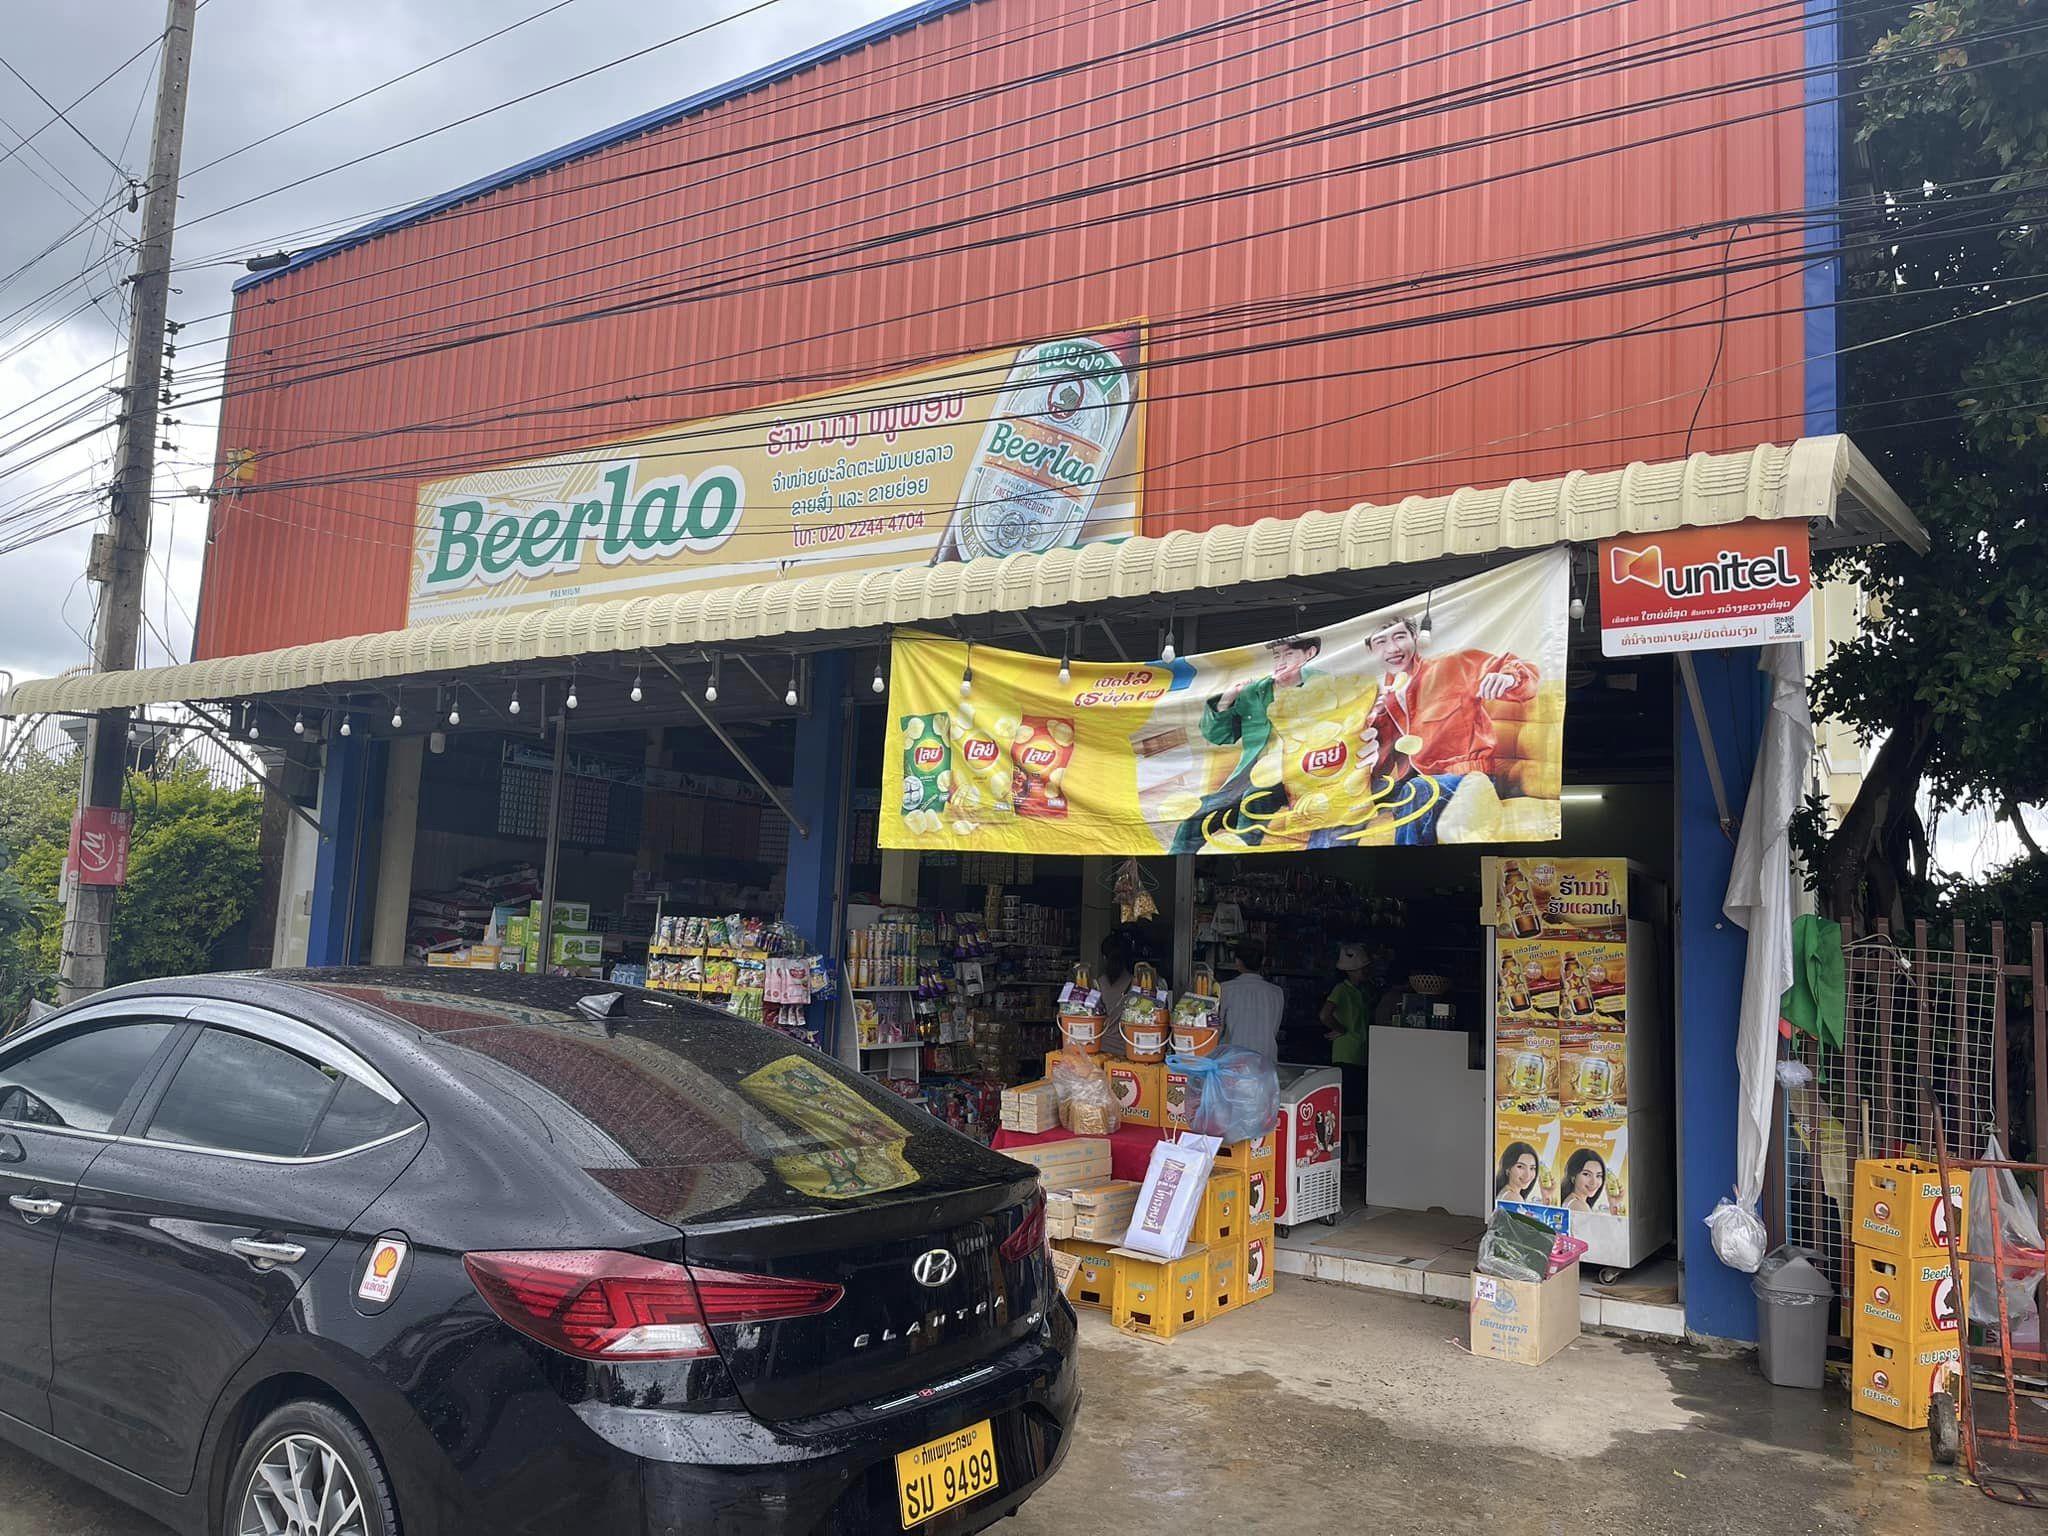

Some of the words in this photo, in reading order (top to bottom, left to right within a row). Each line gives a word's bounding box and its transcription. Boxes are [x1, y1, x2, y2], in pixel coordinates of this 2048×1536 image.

[985, 423, 1096, 487] Beerlao
[425, 462, 740, 585] Beerlao
[819, 524, 846, 543] 020
[849, 518, 884, 539] 2244
[887, 510, 925, 532] 4704
[1665, 547, 1799, 598] unitel
[550, 586, 581, 599] PREMIUM
[1922, 1184, 1962, 1197] Beeao
[1863, 1218, 1901, 1237] Beerlao
[1922, 1266, 1953, 1281] Beerl
[853, 1295, 1006, 1348] ELANTRA
[1864, 1303, 1901, 1322] Beerlao
[943, 1448, 993, 1503] 9499
